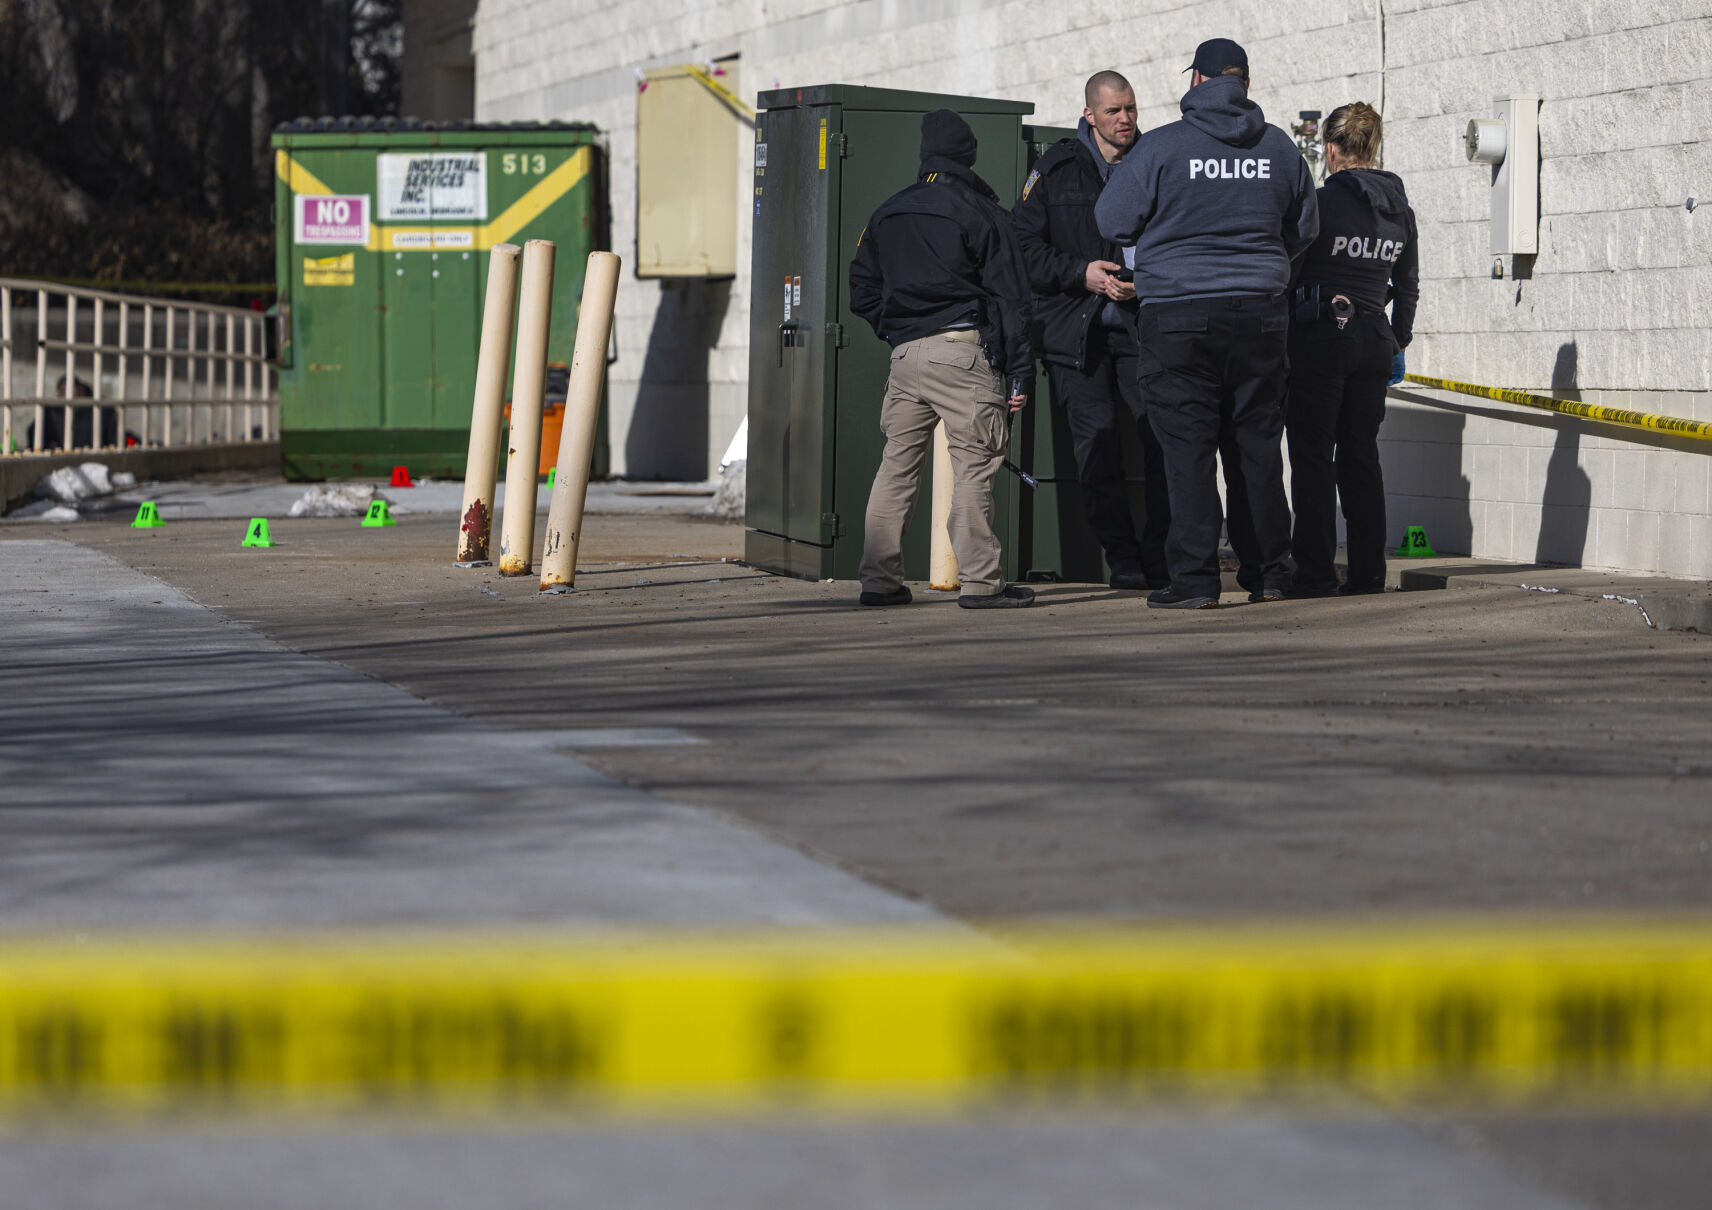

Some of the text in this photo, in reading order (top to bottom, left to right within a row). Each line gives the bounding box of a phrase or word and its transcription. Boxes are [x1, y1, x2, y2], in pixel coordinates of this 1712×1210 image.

[408, 159, 480, 173] INDUSTRIAL
[503, 154, 547, 174] 513
[1189, 158, 1271, 179] POLICE
[405, 173, 464, 187] SERVICES
[401, 188, 425, 203] INC.
[317, 200, 350, 224] NO
[1331, 236, 1404, 262] POLICE
[140, 506, 150, 520] 11
[370, 504, 380, 519] 12
[252, 522, 262, 538] 4
[1411, 531, 1427, 548] 23
